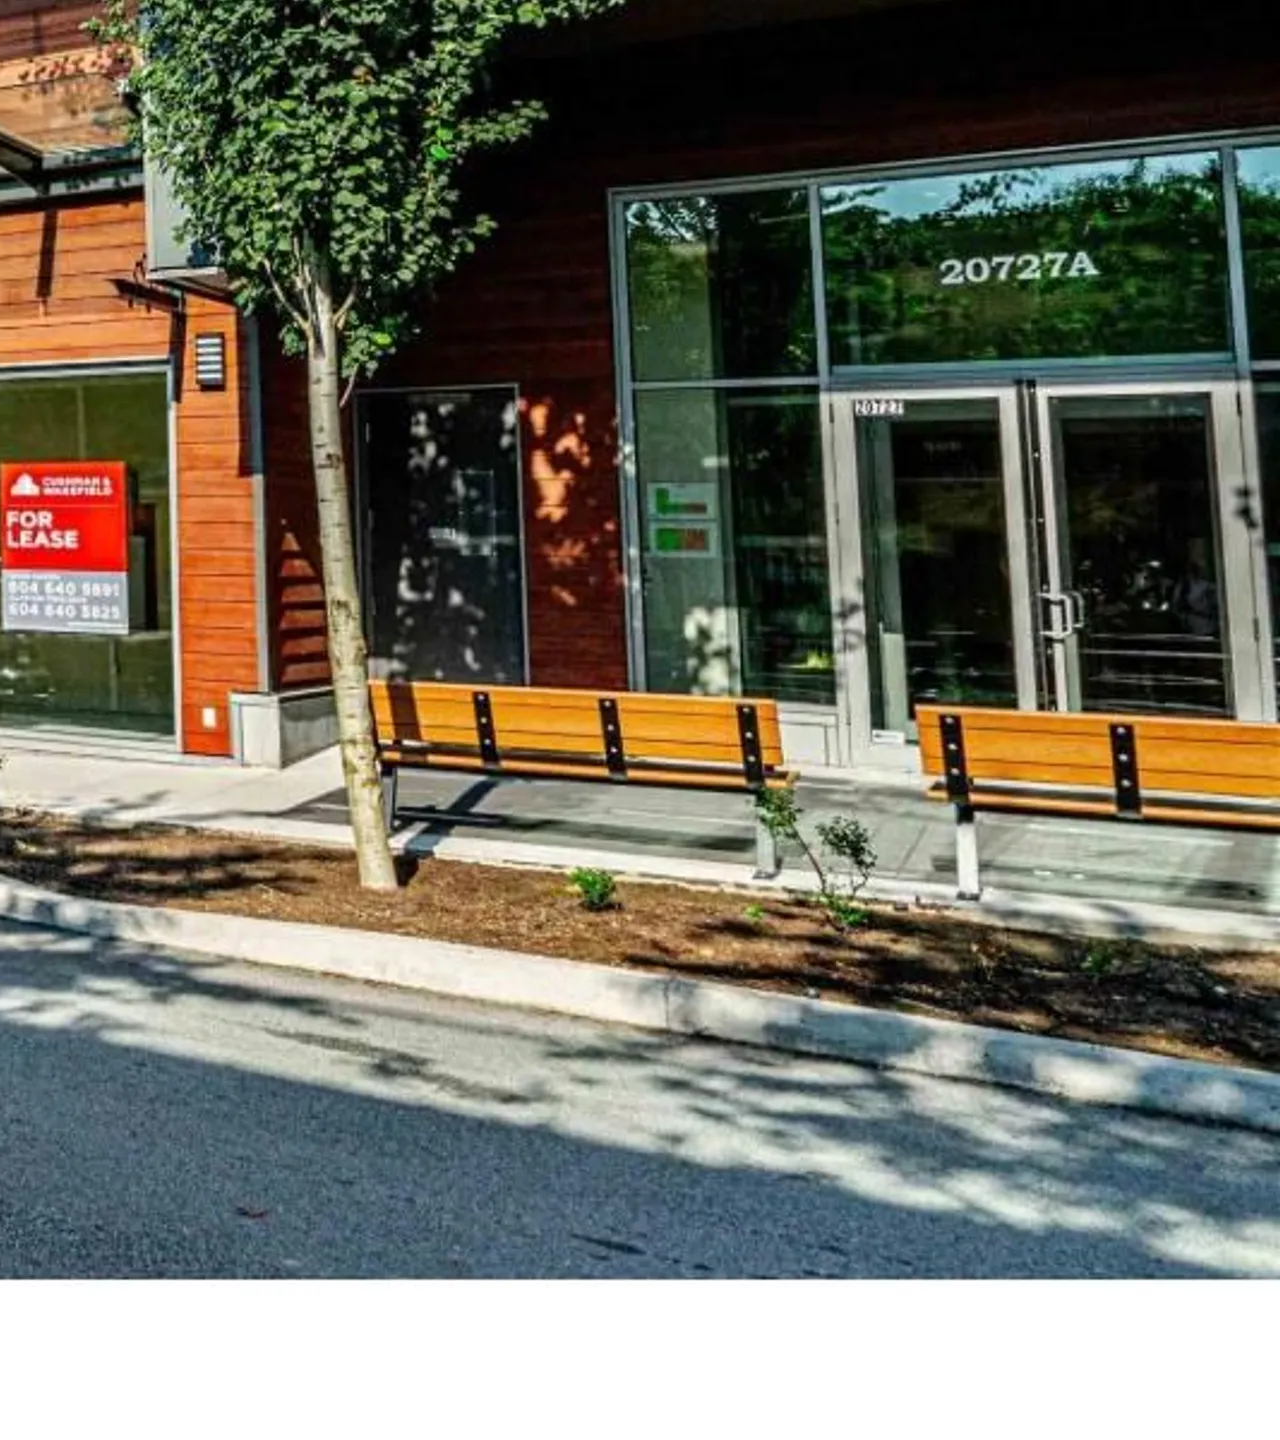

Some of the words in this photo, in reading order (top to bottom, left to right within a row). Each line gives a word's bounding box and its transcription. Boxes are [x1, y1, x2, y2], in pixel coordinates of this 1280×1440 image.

[939, 250, 1101, 285] 20727A
[6, 511, 53, 529] FOR
[6, 530, 80, 549] LEASE
